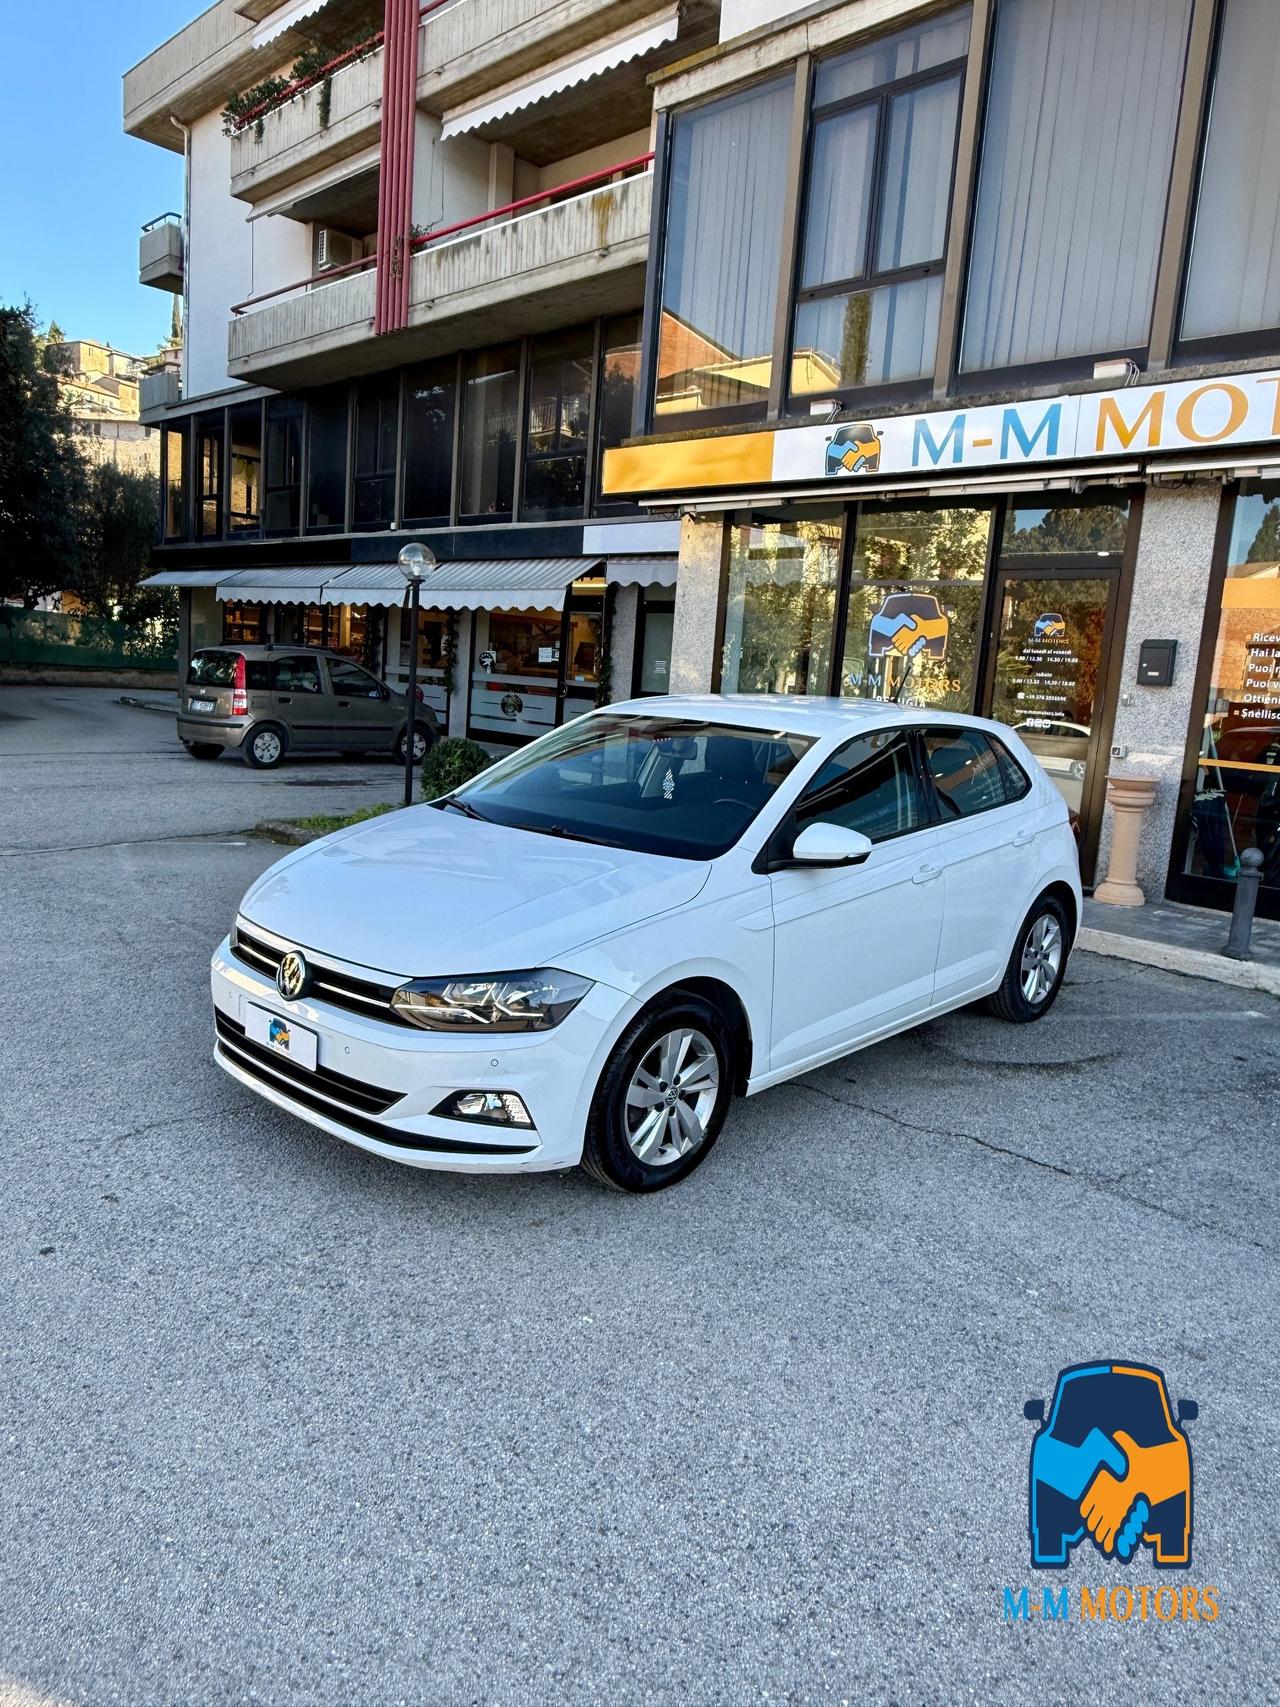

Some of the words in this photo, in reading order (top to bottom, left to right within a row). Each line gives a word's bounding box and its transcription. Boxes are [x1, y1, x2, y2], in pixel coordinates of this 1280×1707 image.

[911, 403, 1062, 467] M-M
[1251, 647, 1269, 658] Hai
[1248, 663, 1272, 673] Puoi
[1246, 678, 1270, 689] Puoi
